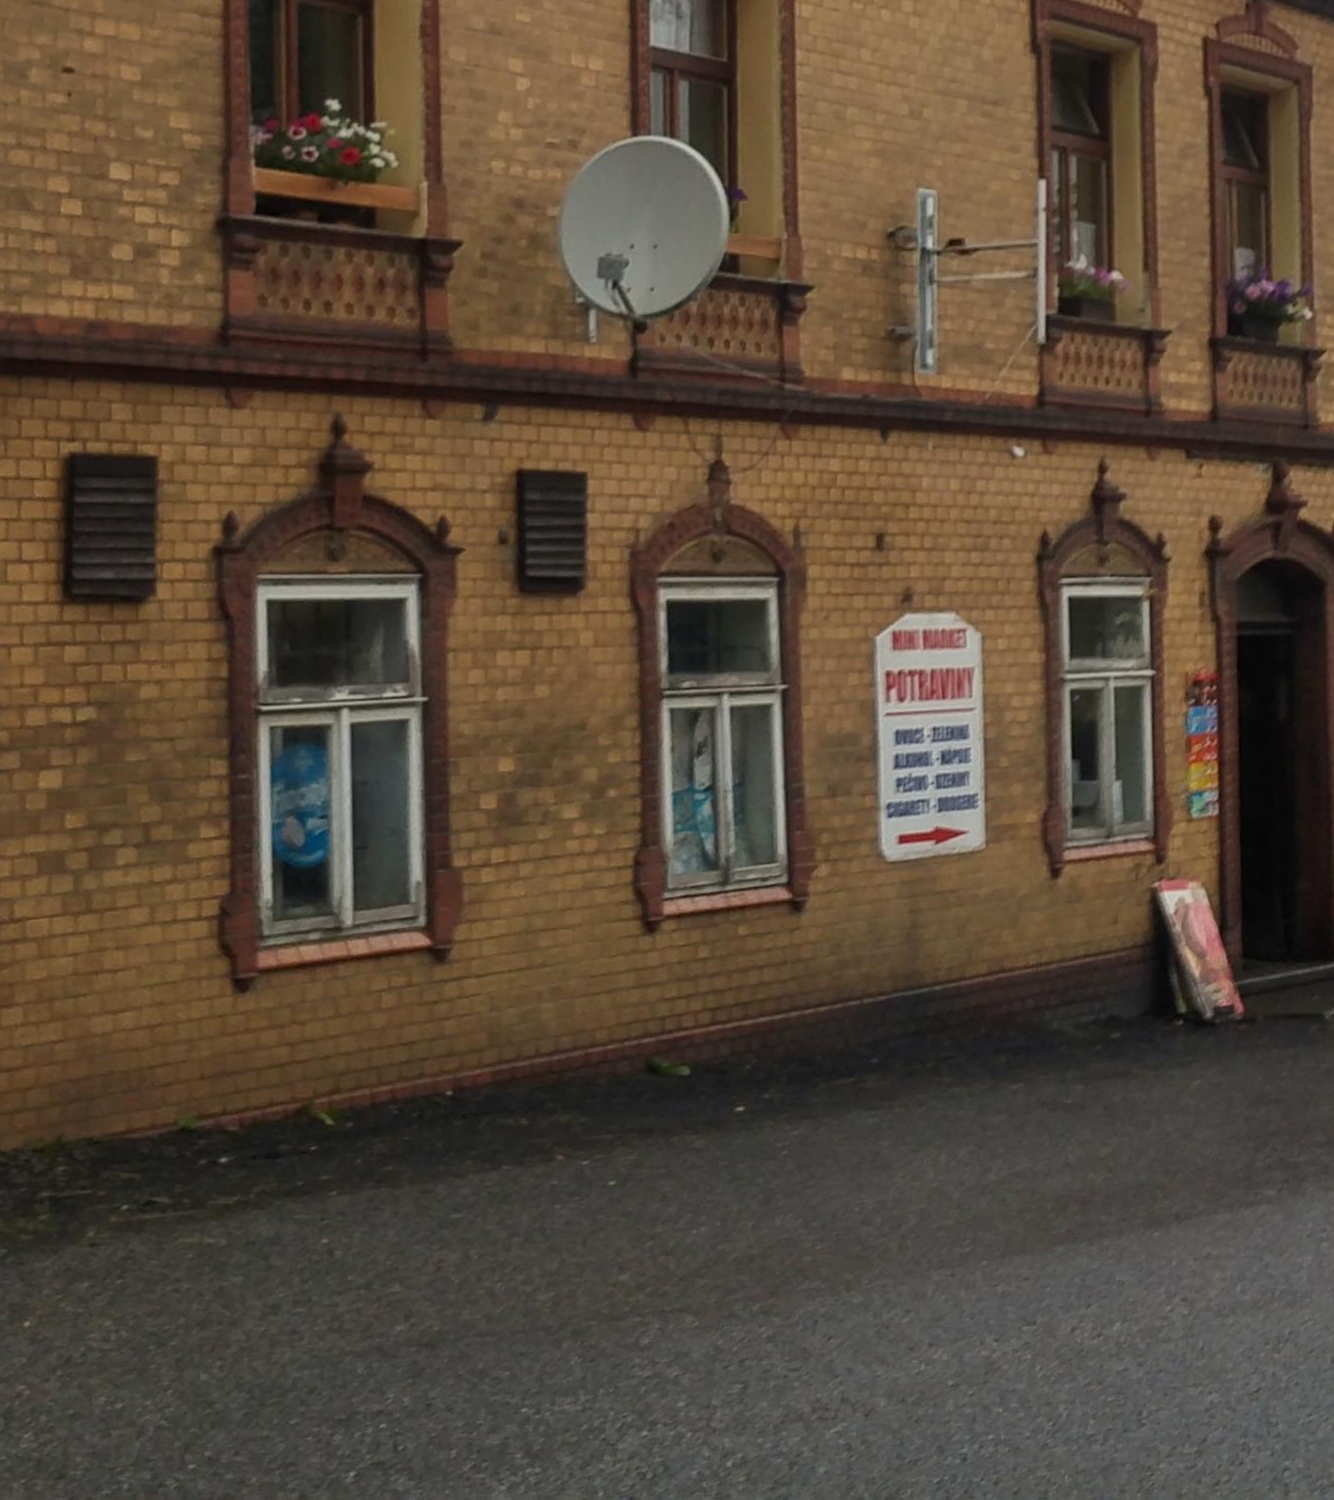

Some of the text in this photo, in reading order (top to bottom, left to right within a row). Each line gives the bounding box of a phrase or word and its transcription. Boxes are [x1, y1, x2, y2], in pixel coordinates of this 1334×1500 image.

[892, 628, 967, 651] MINI MARKET
[885, 667, 975, 703] POTRAVINY
[894, 727, 925, 745] OVOCE
[893, 750, 933, 770] ALKOHOL
[895, 772, 929, 793] PEČIVO
[886, 798, 930, 818] CIGARETY
